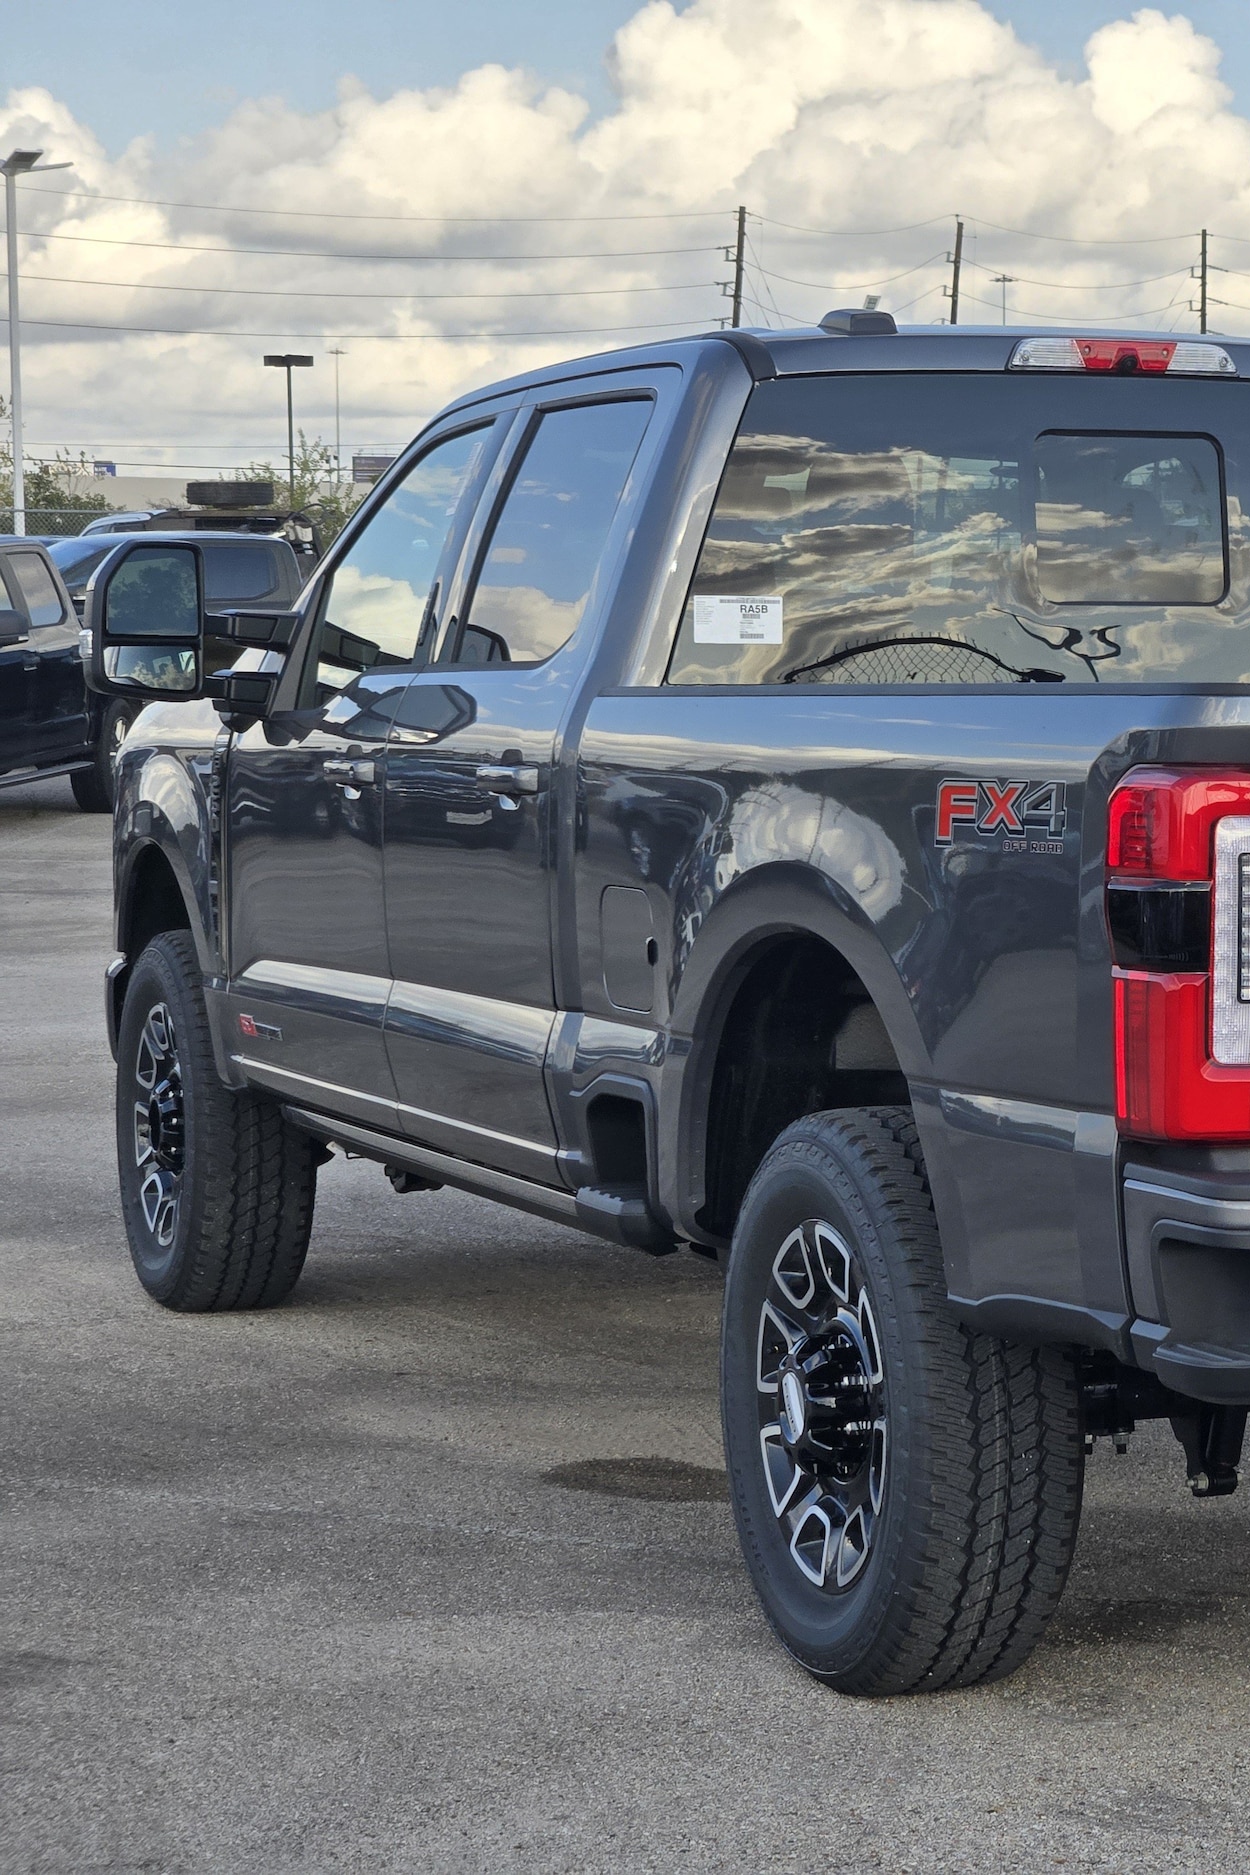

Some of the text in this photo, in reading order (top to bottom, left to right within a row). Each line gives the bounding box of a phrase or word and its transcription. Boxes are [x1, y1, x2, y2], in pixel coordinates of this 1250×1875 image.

[740, 604, 768, 614] RA5B
[934, 778, 1067, 848] FX4
[1003, 840, 1064, 854] OFF ROAD
